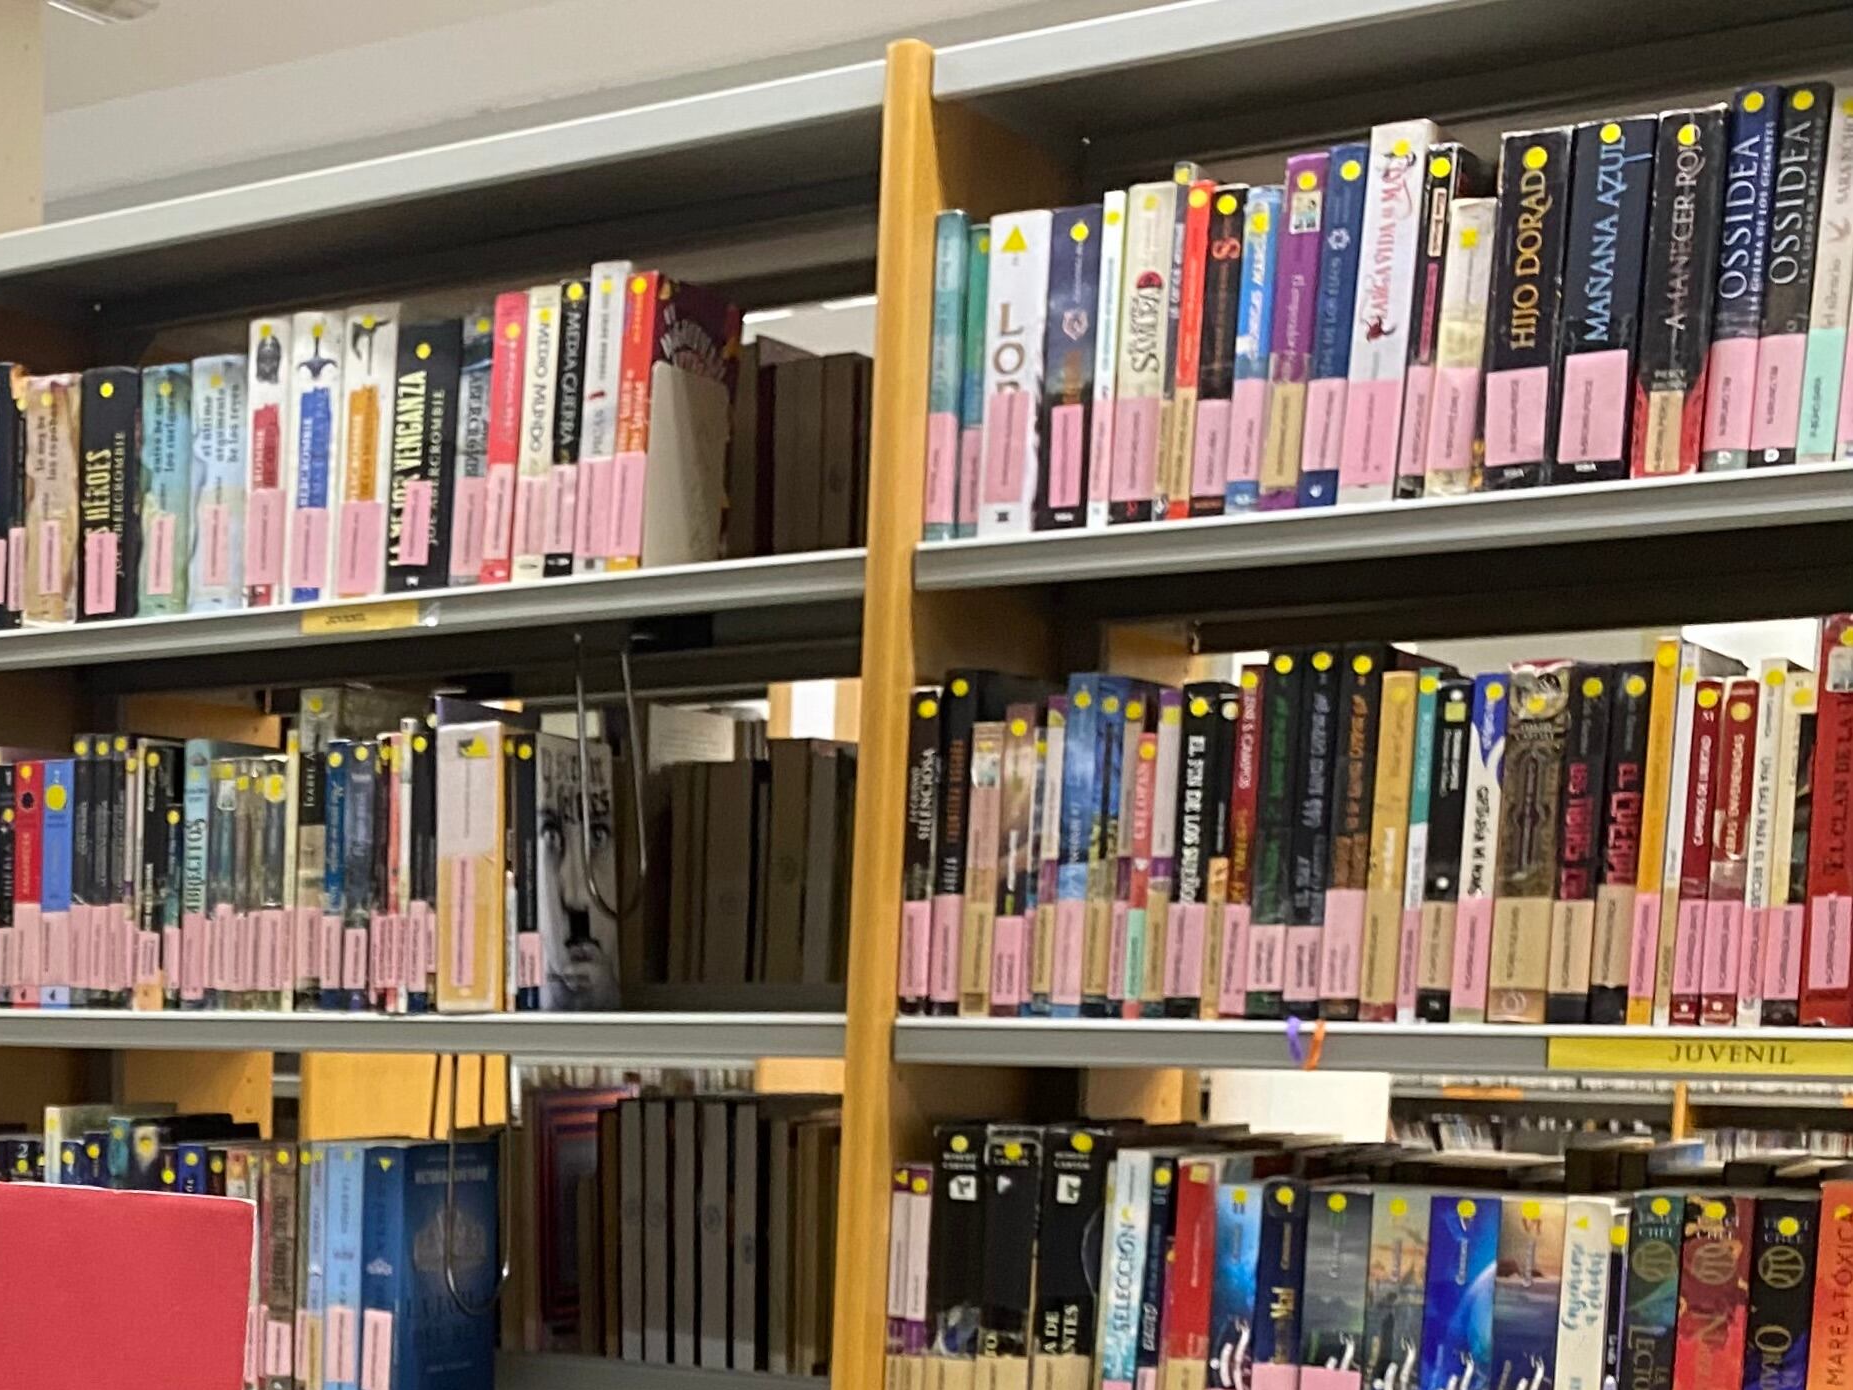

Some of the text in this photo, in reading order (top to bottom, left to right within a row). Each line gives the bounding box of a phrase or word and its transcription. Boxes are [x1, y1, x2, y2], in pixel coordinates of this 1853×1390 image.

[1583, 134, 1652, 342] MAÑANA AZUL
[1719, 134, 1761, 301] OSSIDEA
[1769, 120, 1811, 285] OSSIDEA
[1510, 285, 1540, 350] HIJO
[394, 369, 428, 473] VENGANZA
[1669, 1044, 1795, 1066] JUVENIL
[1825, 1309, 1851, 1387] MAREA
